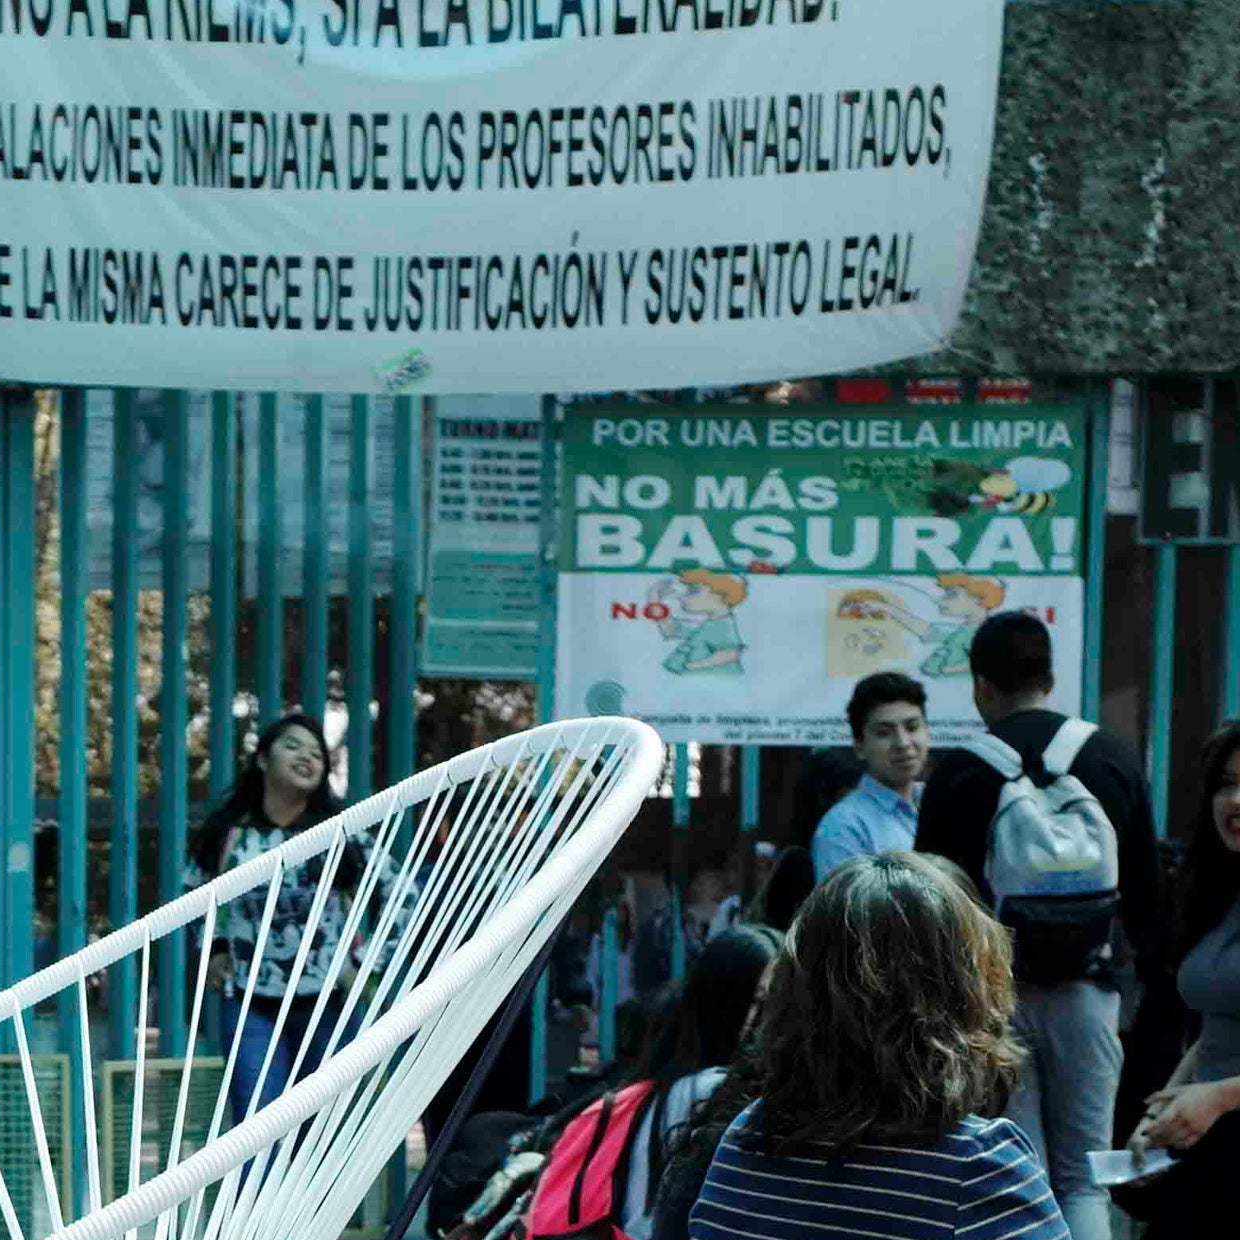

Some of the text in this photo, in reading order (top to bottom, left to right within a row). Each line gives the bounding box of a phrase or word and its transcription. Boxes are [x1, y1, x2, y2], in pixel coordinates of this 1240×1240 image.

[172, 109, 337, 191] INMEDIATA
[348, 113, 389, 191] DE
[402, 111, 465, 191] LOS
[478, 100, 695, 190] PROFESORES
[709, 83, 951, 180] INHABILITADOS,
[22, 245, 60, 321] LA
[67, 248, 165, 325] MISMA
[175, 251, 303, 330] CARECE
[313, 256, 354, 331] DE
[365, 230, 606, 331] JUSTIFICACIÓN
[615, 250, 638, 325] Y
[645, 239, 811, 324] SUSTENTO
[819, 233, 920, 313] LEGAL.
[592, 419, 1074, 448] POR UNA ESCUELA LIMPIA
[575, 474, 671, 509] NO
[694, 467, 839, 510] MÁS
[575, 513, 1076, 570] BASURA!
[611, 602, 670, 622] NO
